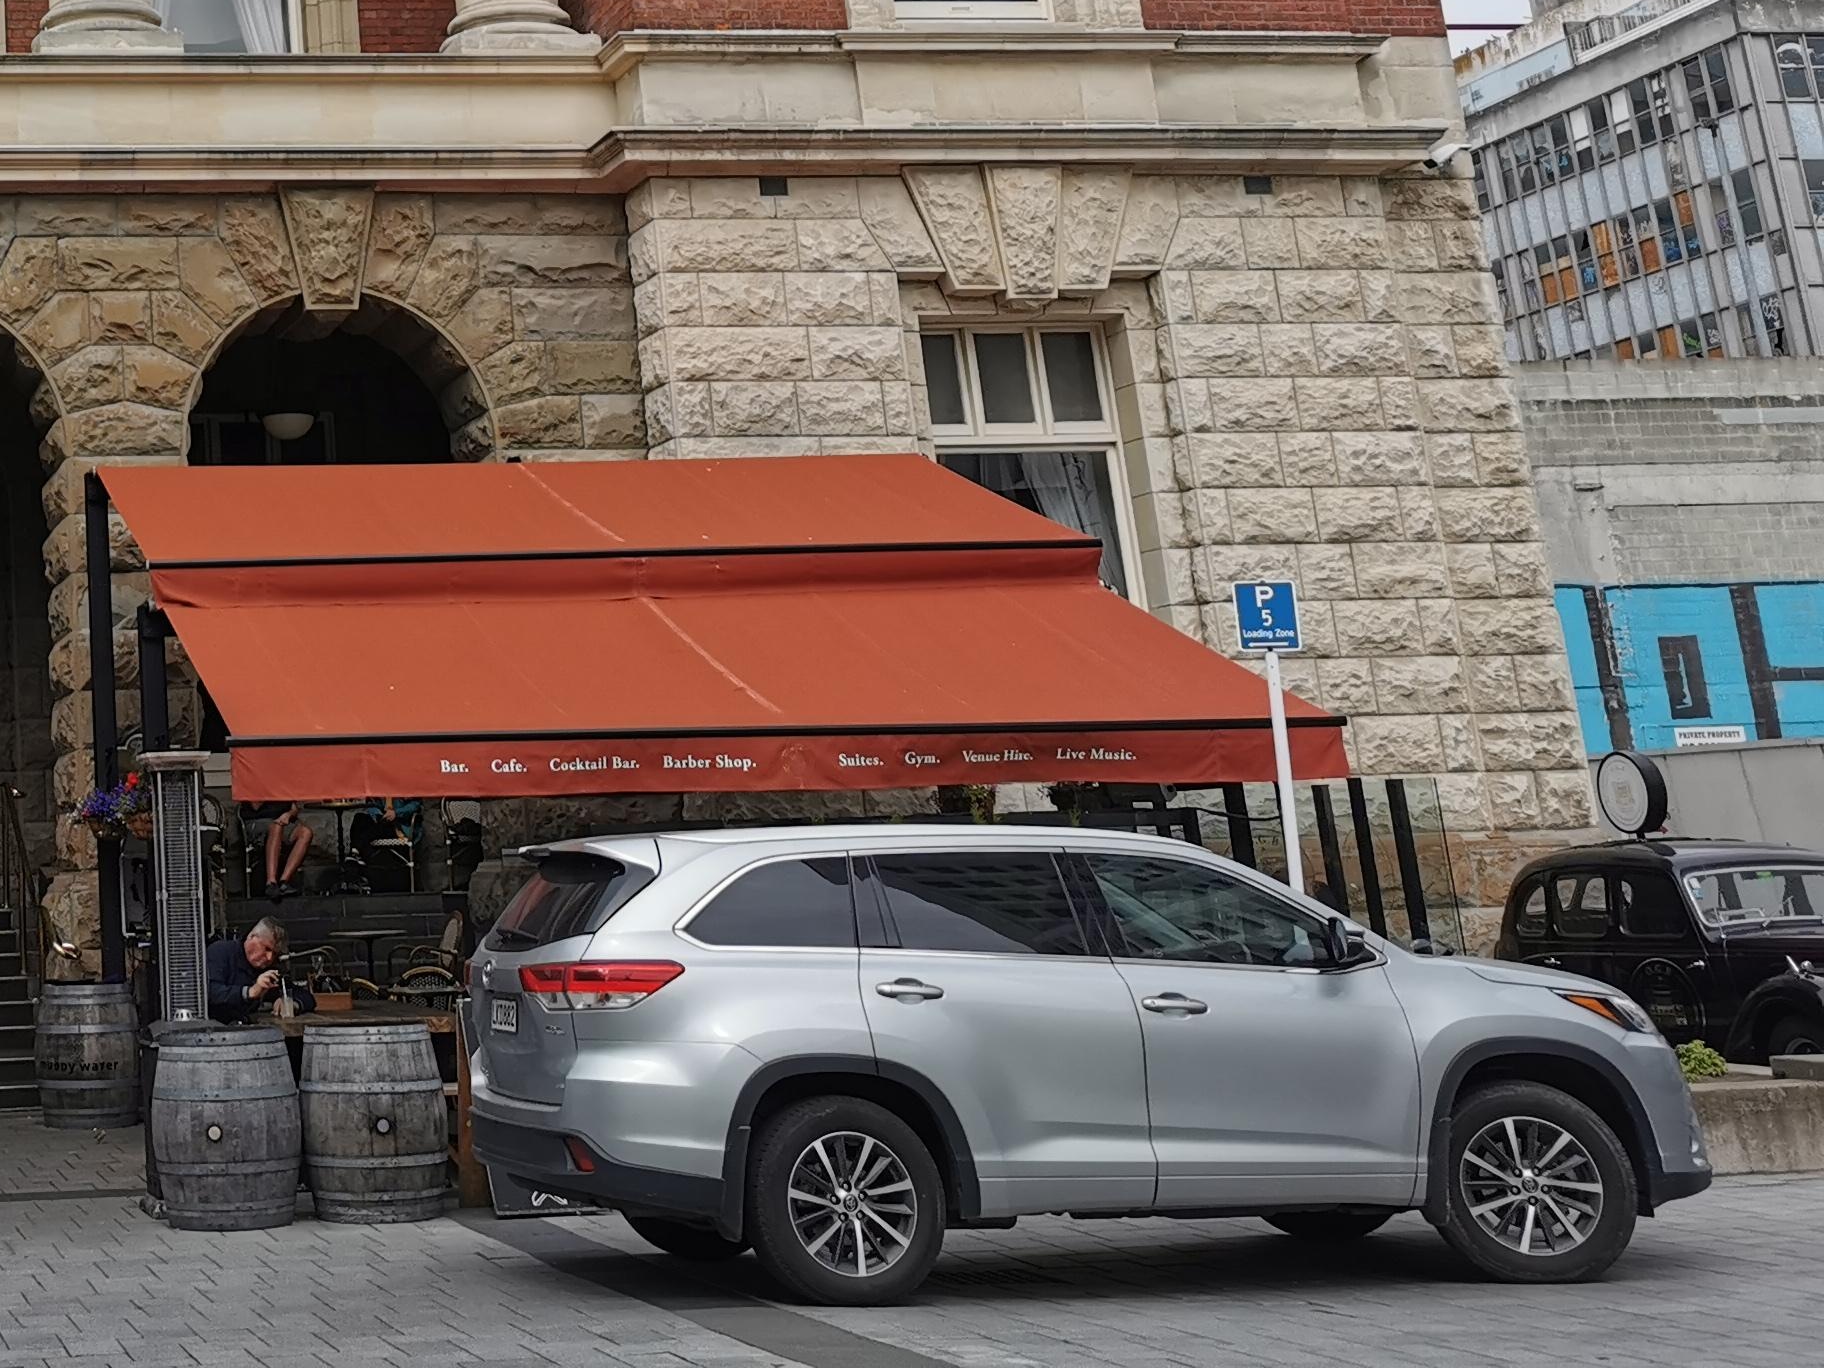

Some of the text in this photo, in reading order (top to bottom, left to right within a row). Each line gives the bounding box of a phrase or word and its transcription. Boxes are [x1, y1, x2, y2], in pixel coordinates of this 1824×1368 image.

[1255, 586, 1274, 607] P
[1261, 609, 1272, 626] 5
[1242, 628, 1294, 639] Loading Zone
[1678, 730, 1740, 740] PRIVATE PROPERTY
[440, 747, 1137, 773] Bar. Cafe. Cocktail Bar. Barber Shop. Suites. Gym. Venue Hire. Live Music.
